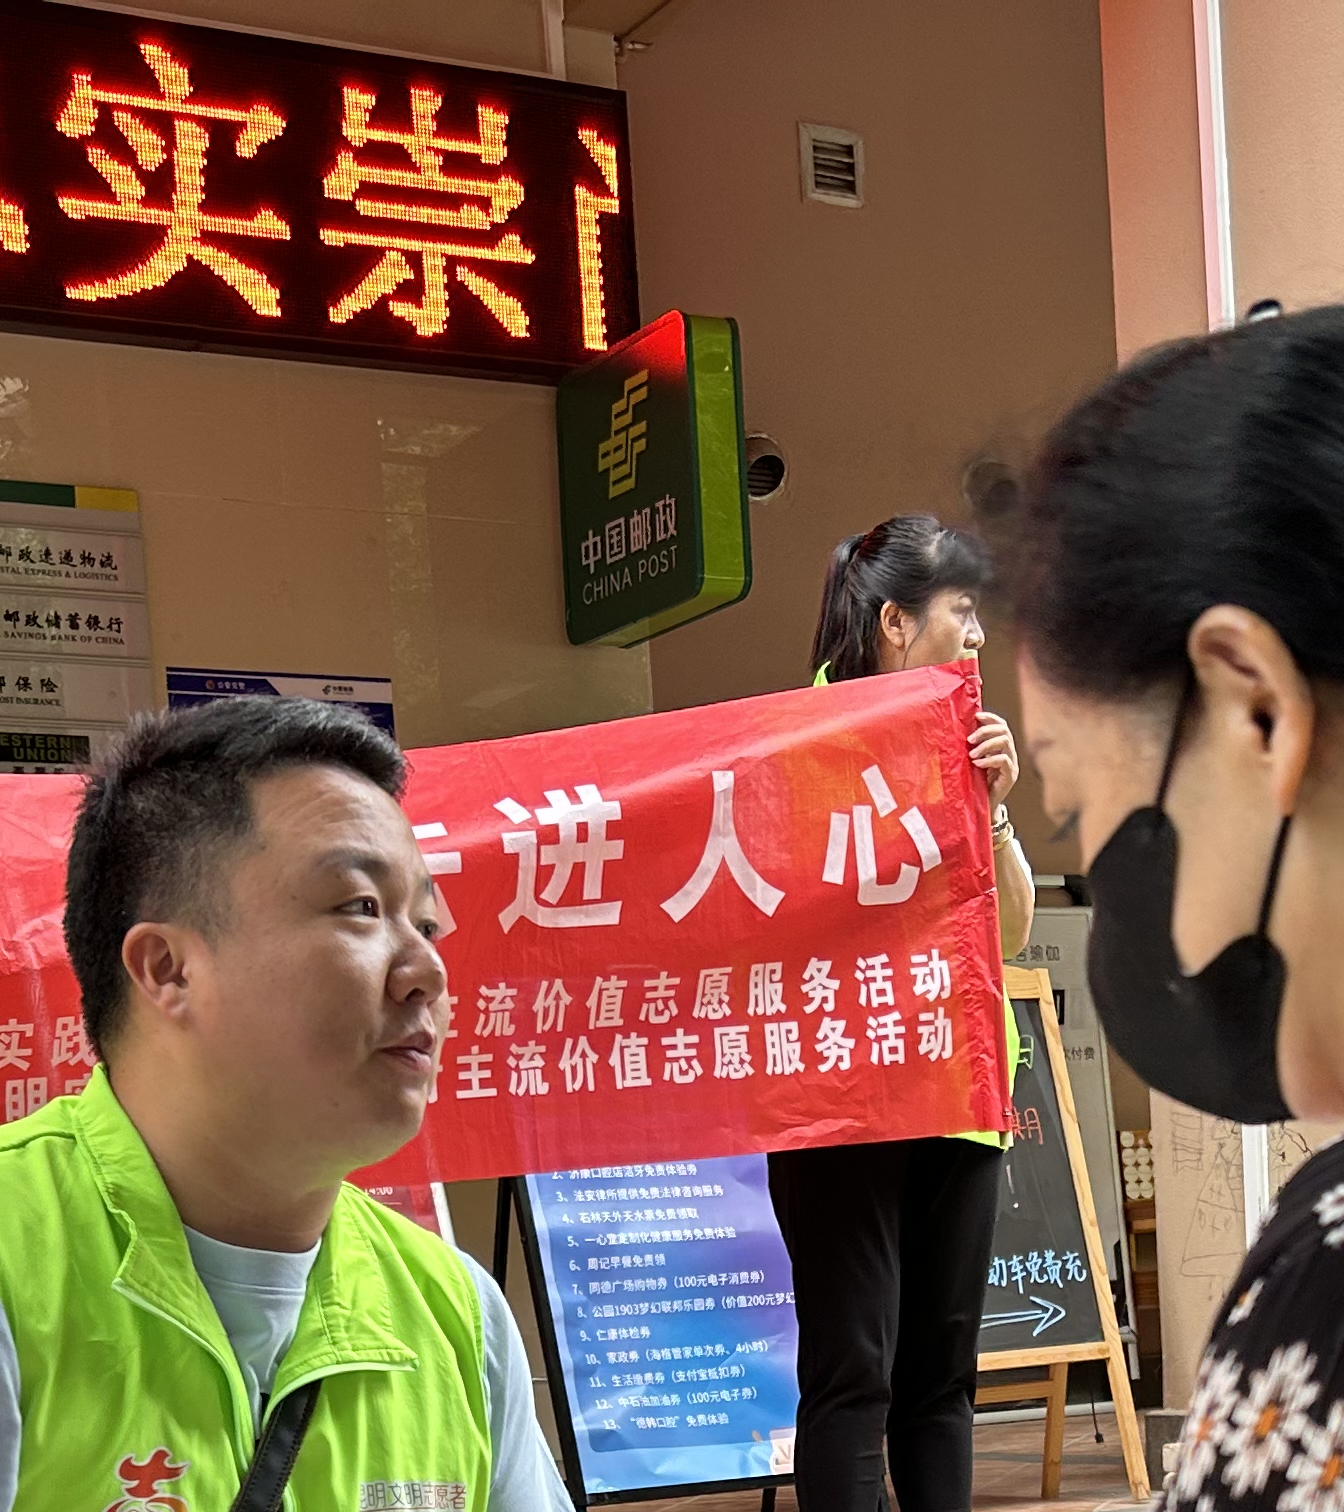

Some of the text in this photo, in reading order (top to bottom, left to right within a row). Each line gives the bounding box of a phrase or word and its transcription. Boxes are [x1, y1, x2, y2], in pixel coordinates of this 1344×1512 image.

[580, 494, 677, 575] 中国邮政
[24, 567, 63, 578] EXPRESS
[73, 571, 119, 581] LOGISTICS
[582, 545, 678, 605] CHINA POST
[4, 630, 47, 641] SAVINGS
[50, 633, 78, 643] BANK
[80, 635, 92, 644] OF
[95, 636, 125, 646] CHINA
[15, 696, 61, 706] INSURANCE
[13, 747, 72, 761] UNION
[446, 948, 952, 1040] 流价值志愿服务活动
